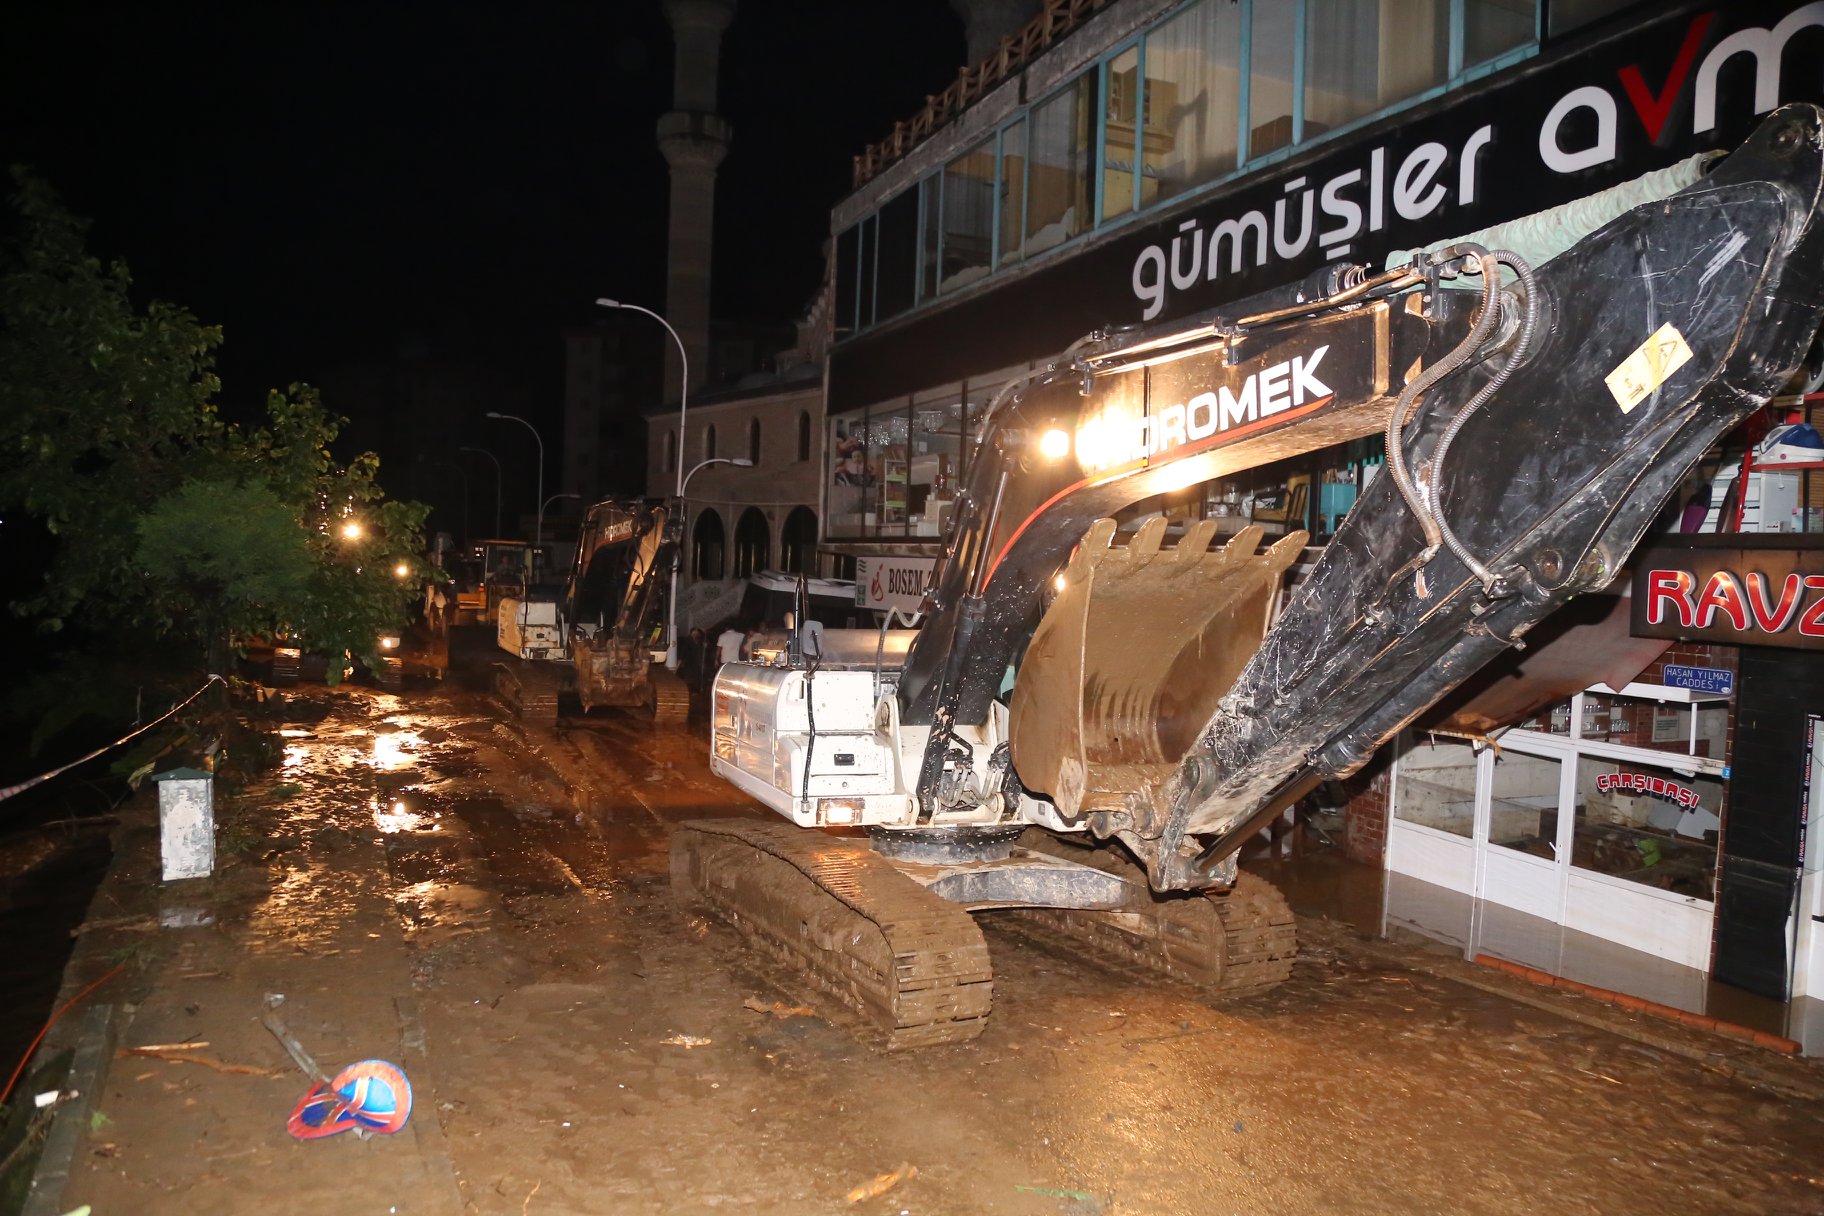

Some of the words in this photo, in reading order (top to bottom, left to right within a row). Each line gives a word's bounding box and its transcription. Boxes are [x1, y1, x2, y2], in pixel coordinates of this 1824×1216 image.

[888, 568, 924, 596] BOSEM
[1666, 668, 1693, 678] HASAN
[1697, 671, 1730, 682] YILMAZ
